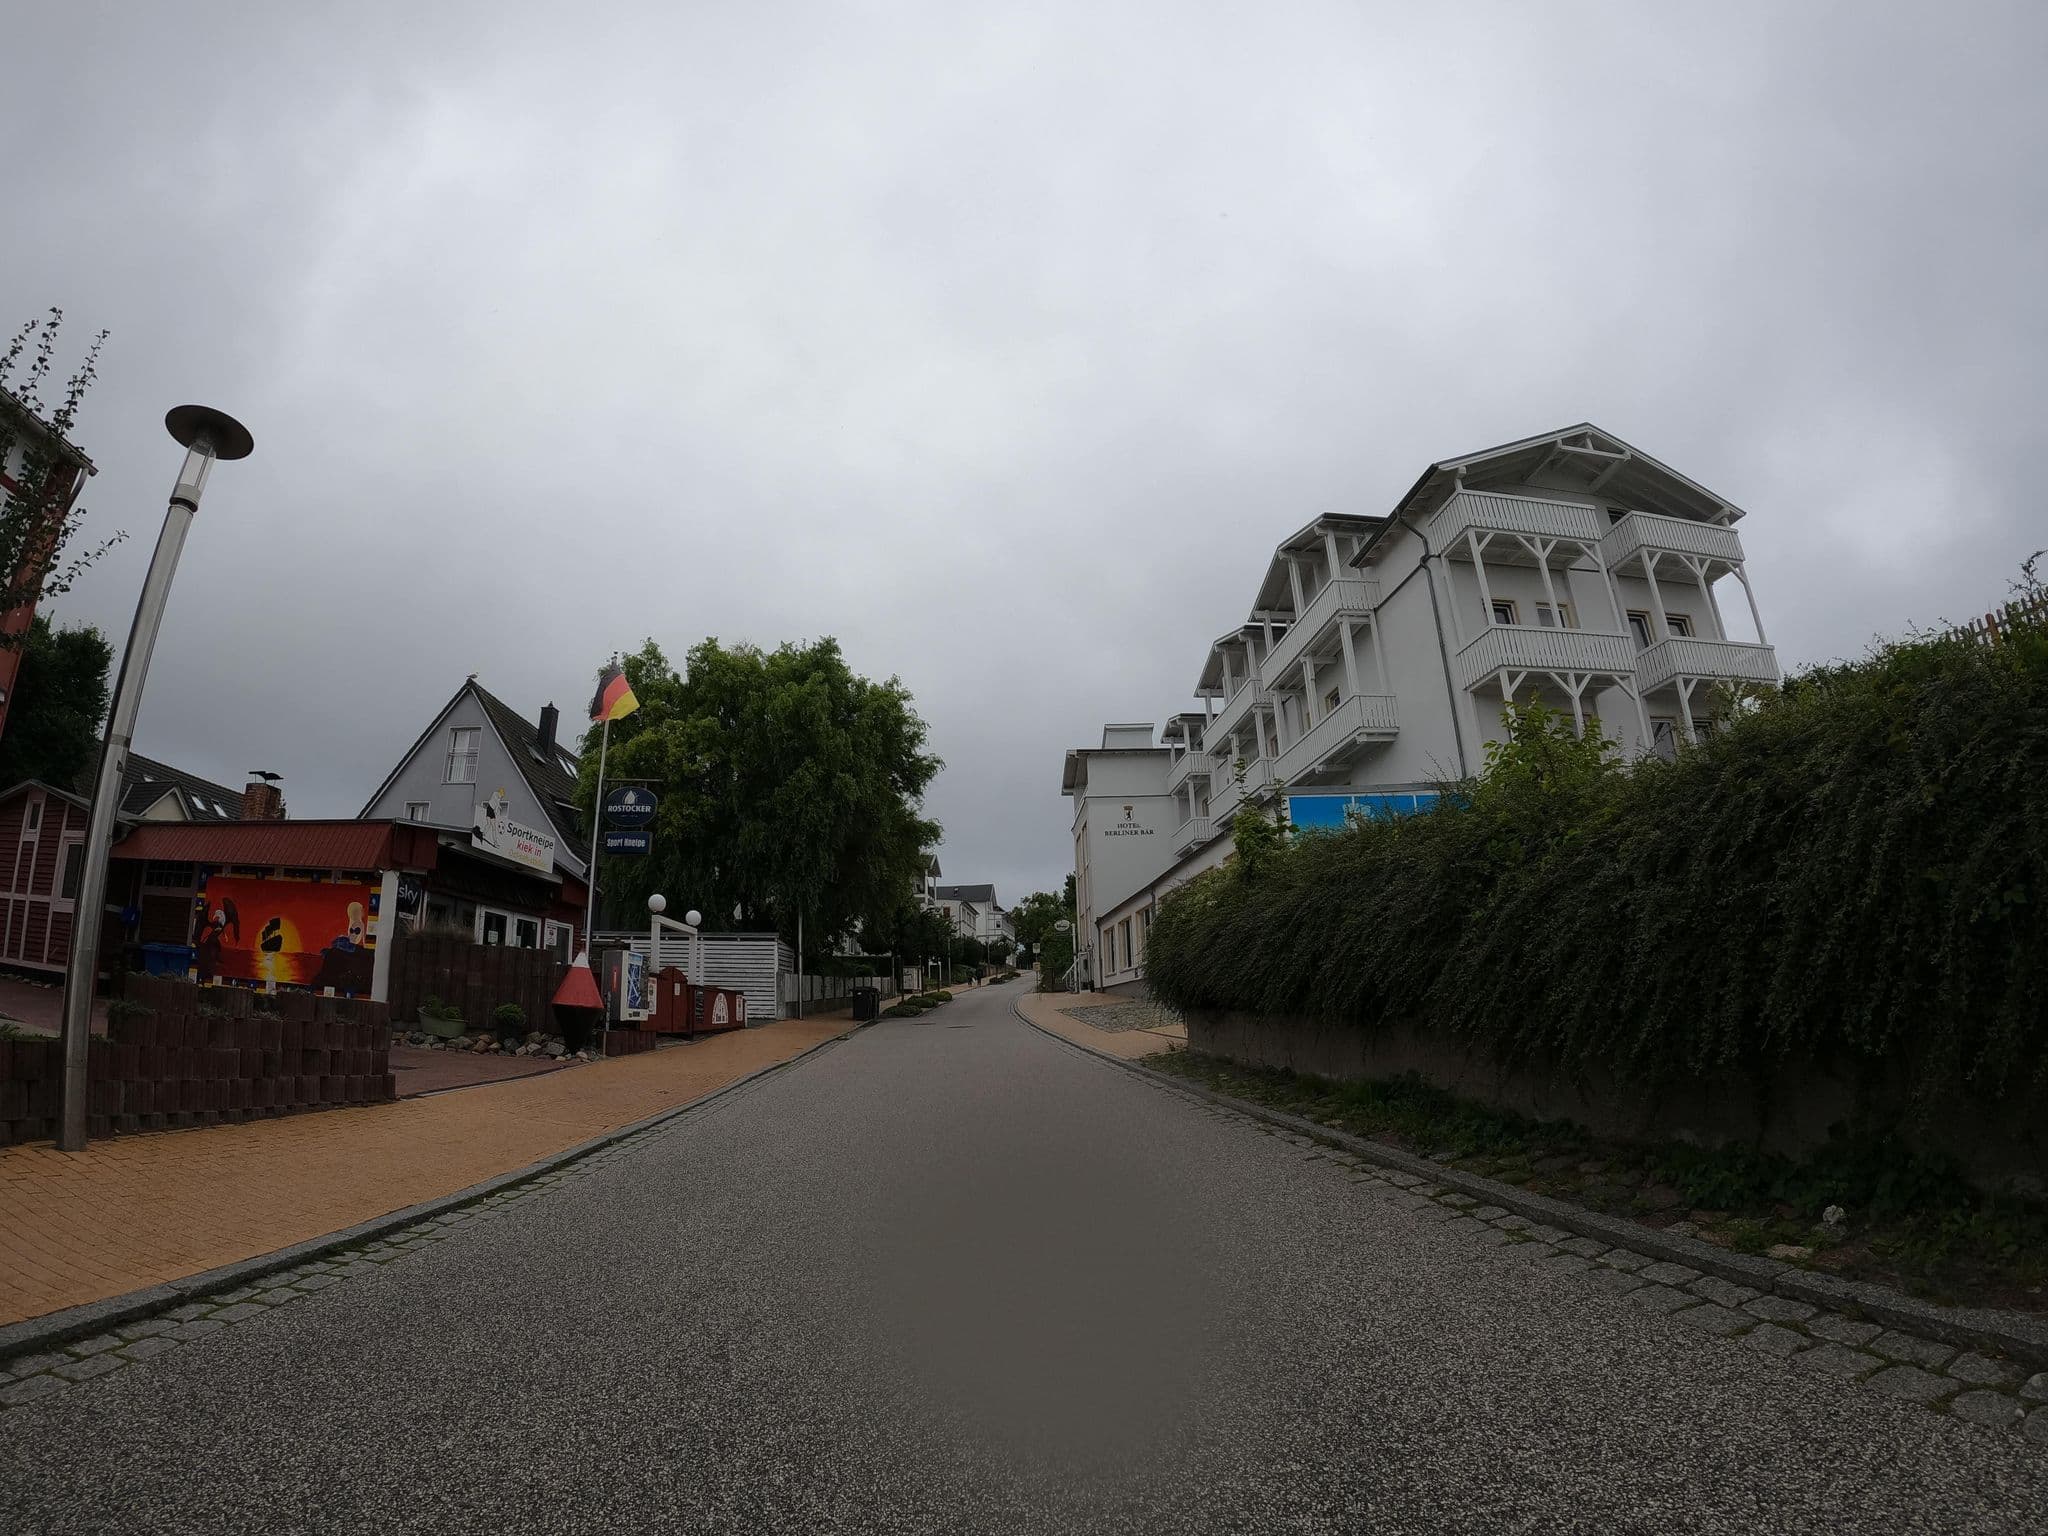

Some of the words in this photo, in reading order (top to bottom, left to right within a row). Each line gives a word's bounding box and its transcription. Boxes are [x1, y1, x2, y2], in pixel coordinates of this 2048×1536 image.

[607, 805, 652, 813] ROSTOCKER
[506, 822, 554, 850] Sportkneipe
[606, 838, 623, 847] Sport
[623, 838, 646, 848] Kneipe
[534, 846, 542, 857] in
[398, 884, 418, 905] sky
